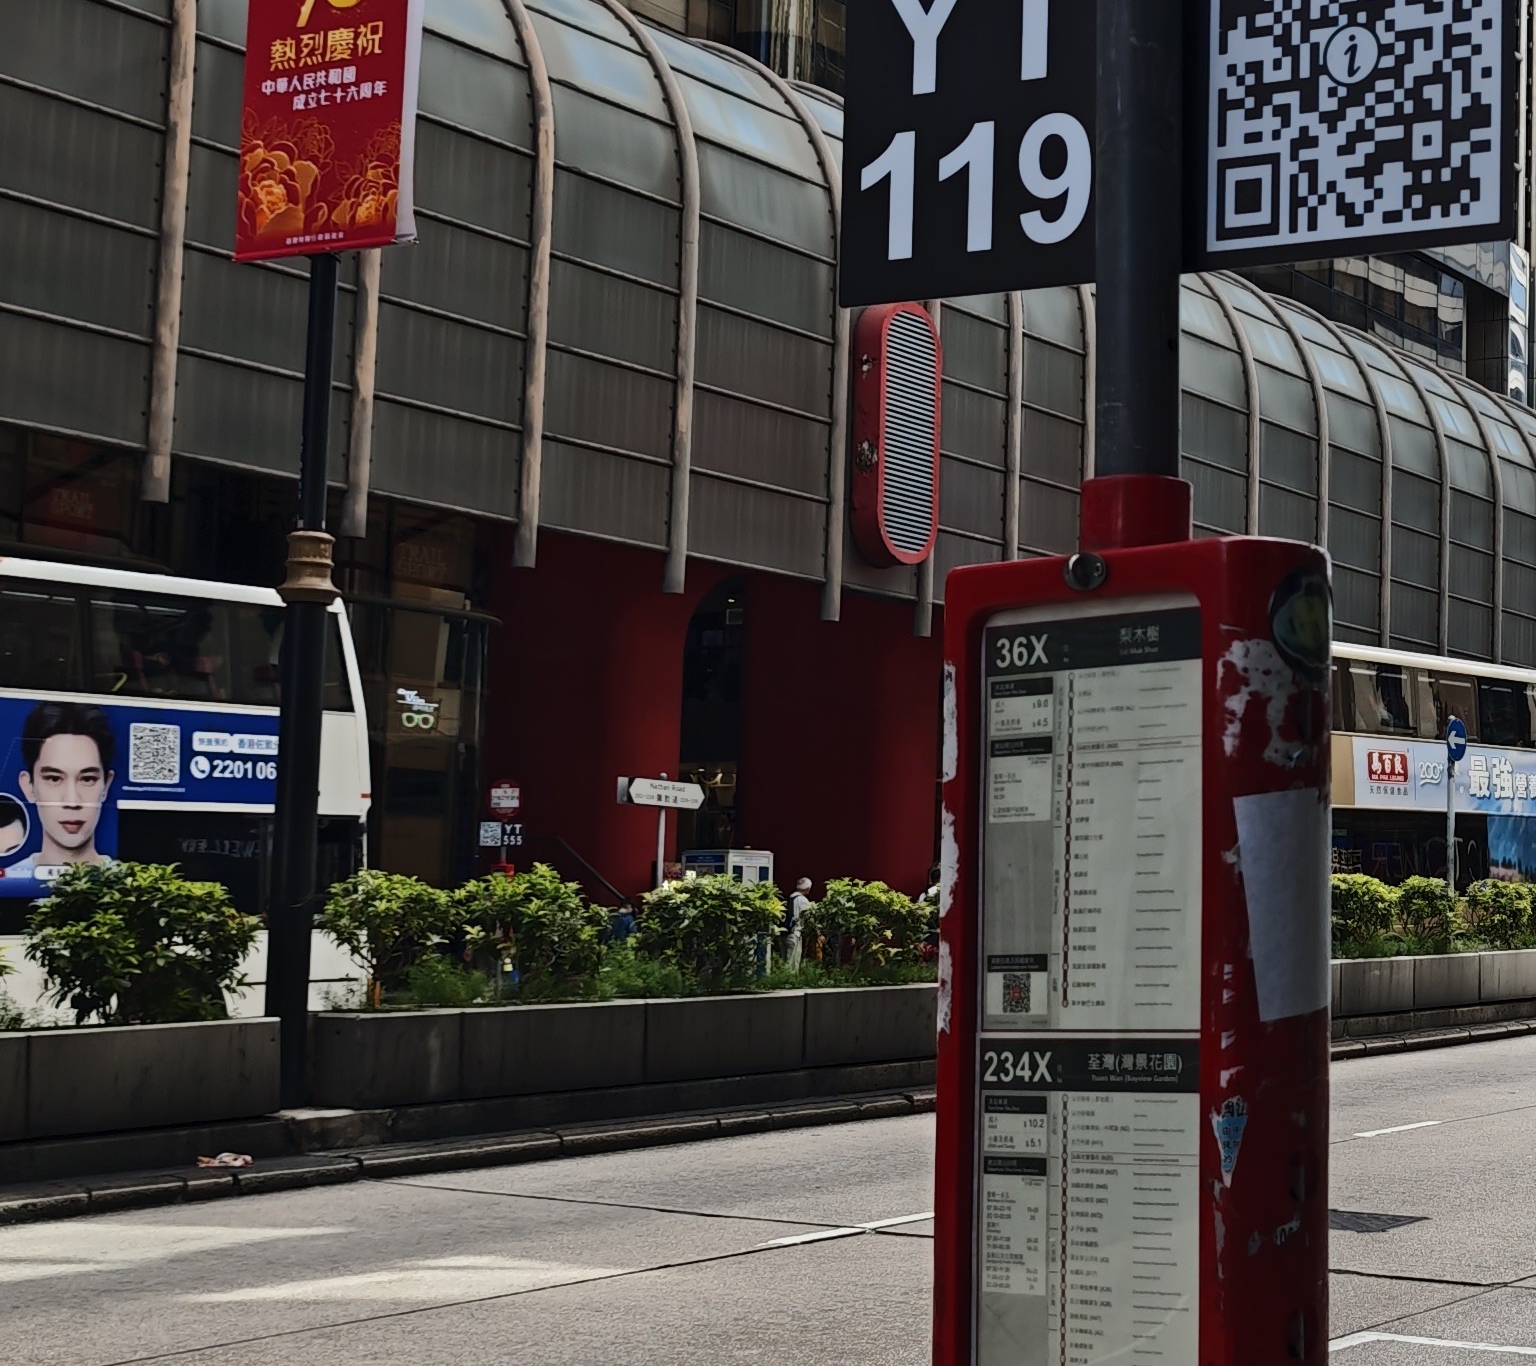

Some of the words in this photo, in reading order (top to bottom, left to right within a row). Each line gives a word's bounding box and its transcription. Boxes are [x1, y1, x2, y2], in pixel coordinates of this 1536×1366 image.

[270, 21, 383, 72] 熱烈慶祝
[261, 66, 357, 96] 中華人民共和國
[292, 80, 388, 111] 成立七十六周年
[860, 112, 1092, 261] 119
[996, 634, 1049, 668] 36X
[212, 760, 252, 779] 2201
[504, 823, 522, 834] YT
[983, 1051, 1052, 1082] 234X
[1087, 1053, 1183, 1074] 荃灣(灣景花園)
